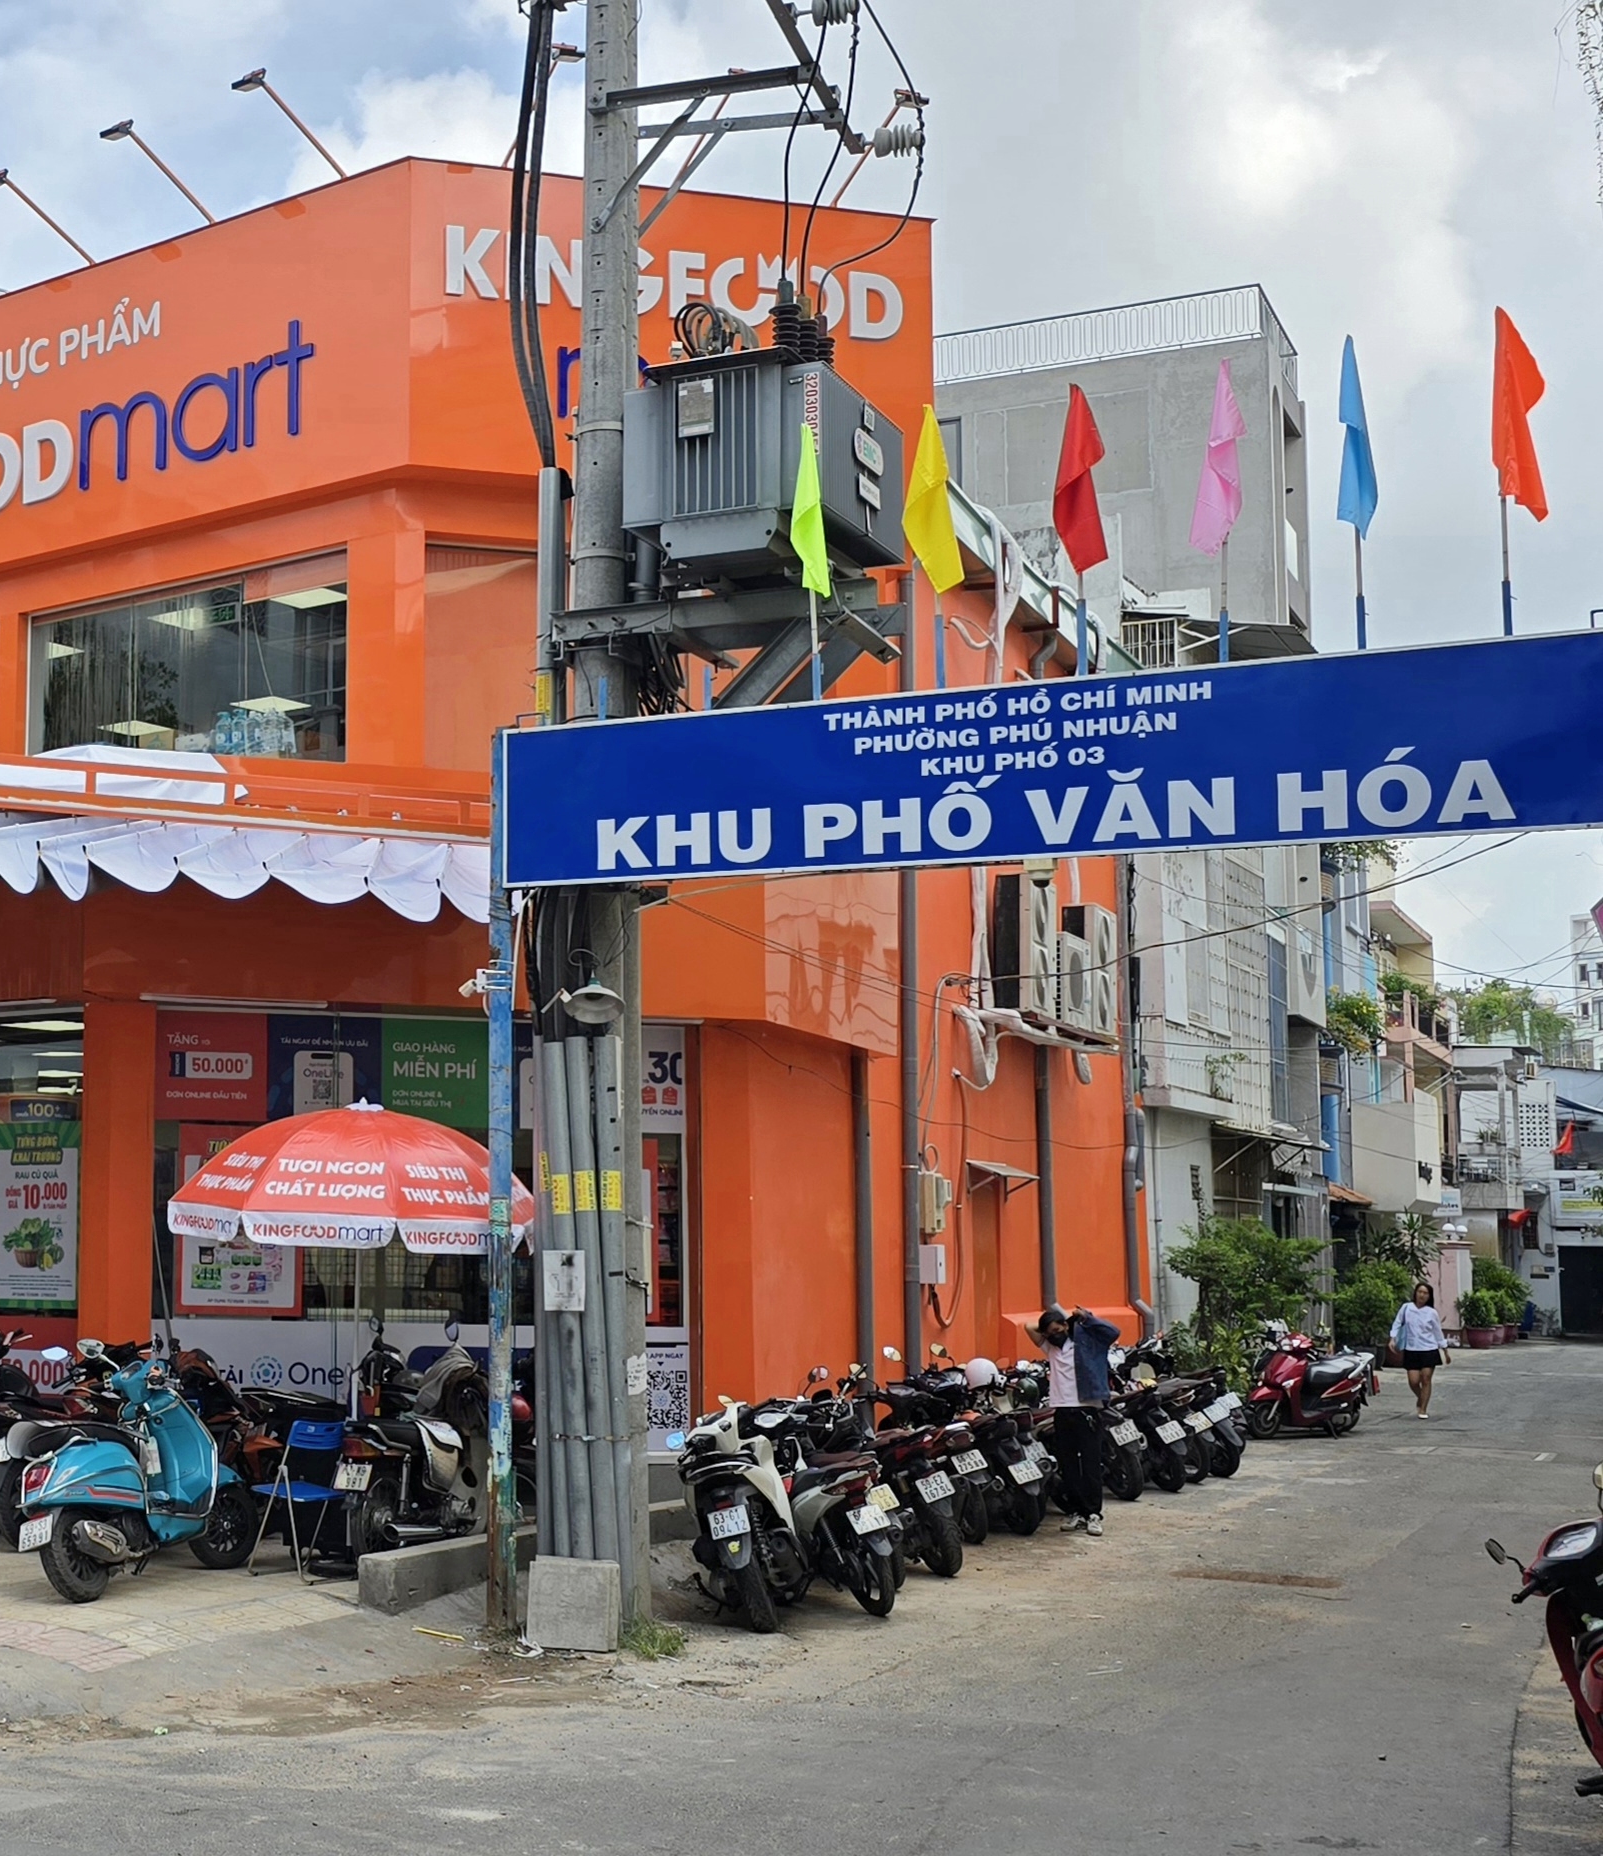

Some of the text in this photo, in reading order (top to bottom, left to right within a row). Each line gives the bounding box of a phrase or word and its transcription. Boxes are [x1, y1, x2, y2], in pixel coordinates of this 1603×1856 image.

[444, 224, 904, 341] KNFOOD
[57, 301, 162, 373] PHẨM
[805, 372, 820, 454] 3203030
[823, 681, 1212, 734] THÀNH PHỐ HỒ CHÍ MINH
[852, 709, 1178, 756] PHƯỜNG PHÚ NHUẬN
[920, 744, 1106, 777] KHU PHỐ 03
[595, 746, 1518, 871] KHU PHỐ VĂN HÓA
[166, 1031, 199, 1048] TẶNG
[292, 1037, 310, 1046] NGAY
[392, 1040, 456, 1055] GIAO HÀNG
[302, 1067, 345, 1080] OneLie
[392, 1054, 478, 1080] MIỄN PHÍ
[185, 1091, 212, 1099] ONLINE
[410, 1090, 436, 1099] ONLINE
[223, 1151, 267, 1172] SIÊU THỊ
[278, 1158, 385, 1176] TƯƠI NGON
[15, 1171, 30, 1180] RAU
[42, 1168, 59, 1180] QUẢ
[404, 1162, 469, 1184] SIÊU THỊ
[22, 1182, 68, 1210] 10.000
[264, 1178, 386, 1201] CHẤT LƯỢNG
[400, 1186, 445, 1206] THỰC
[173, 1213, 233, 1236] KINGFOODma
[252, 1223, 385, 1243] KINGFOODmart
[404, 1231, 515, 1247] KINGFOODm
[665, 1352, 684, 1360] NGAY
